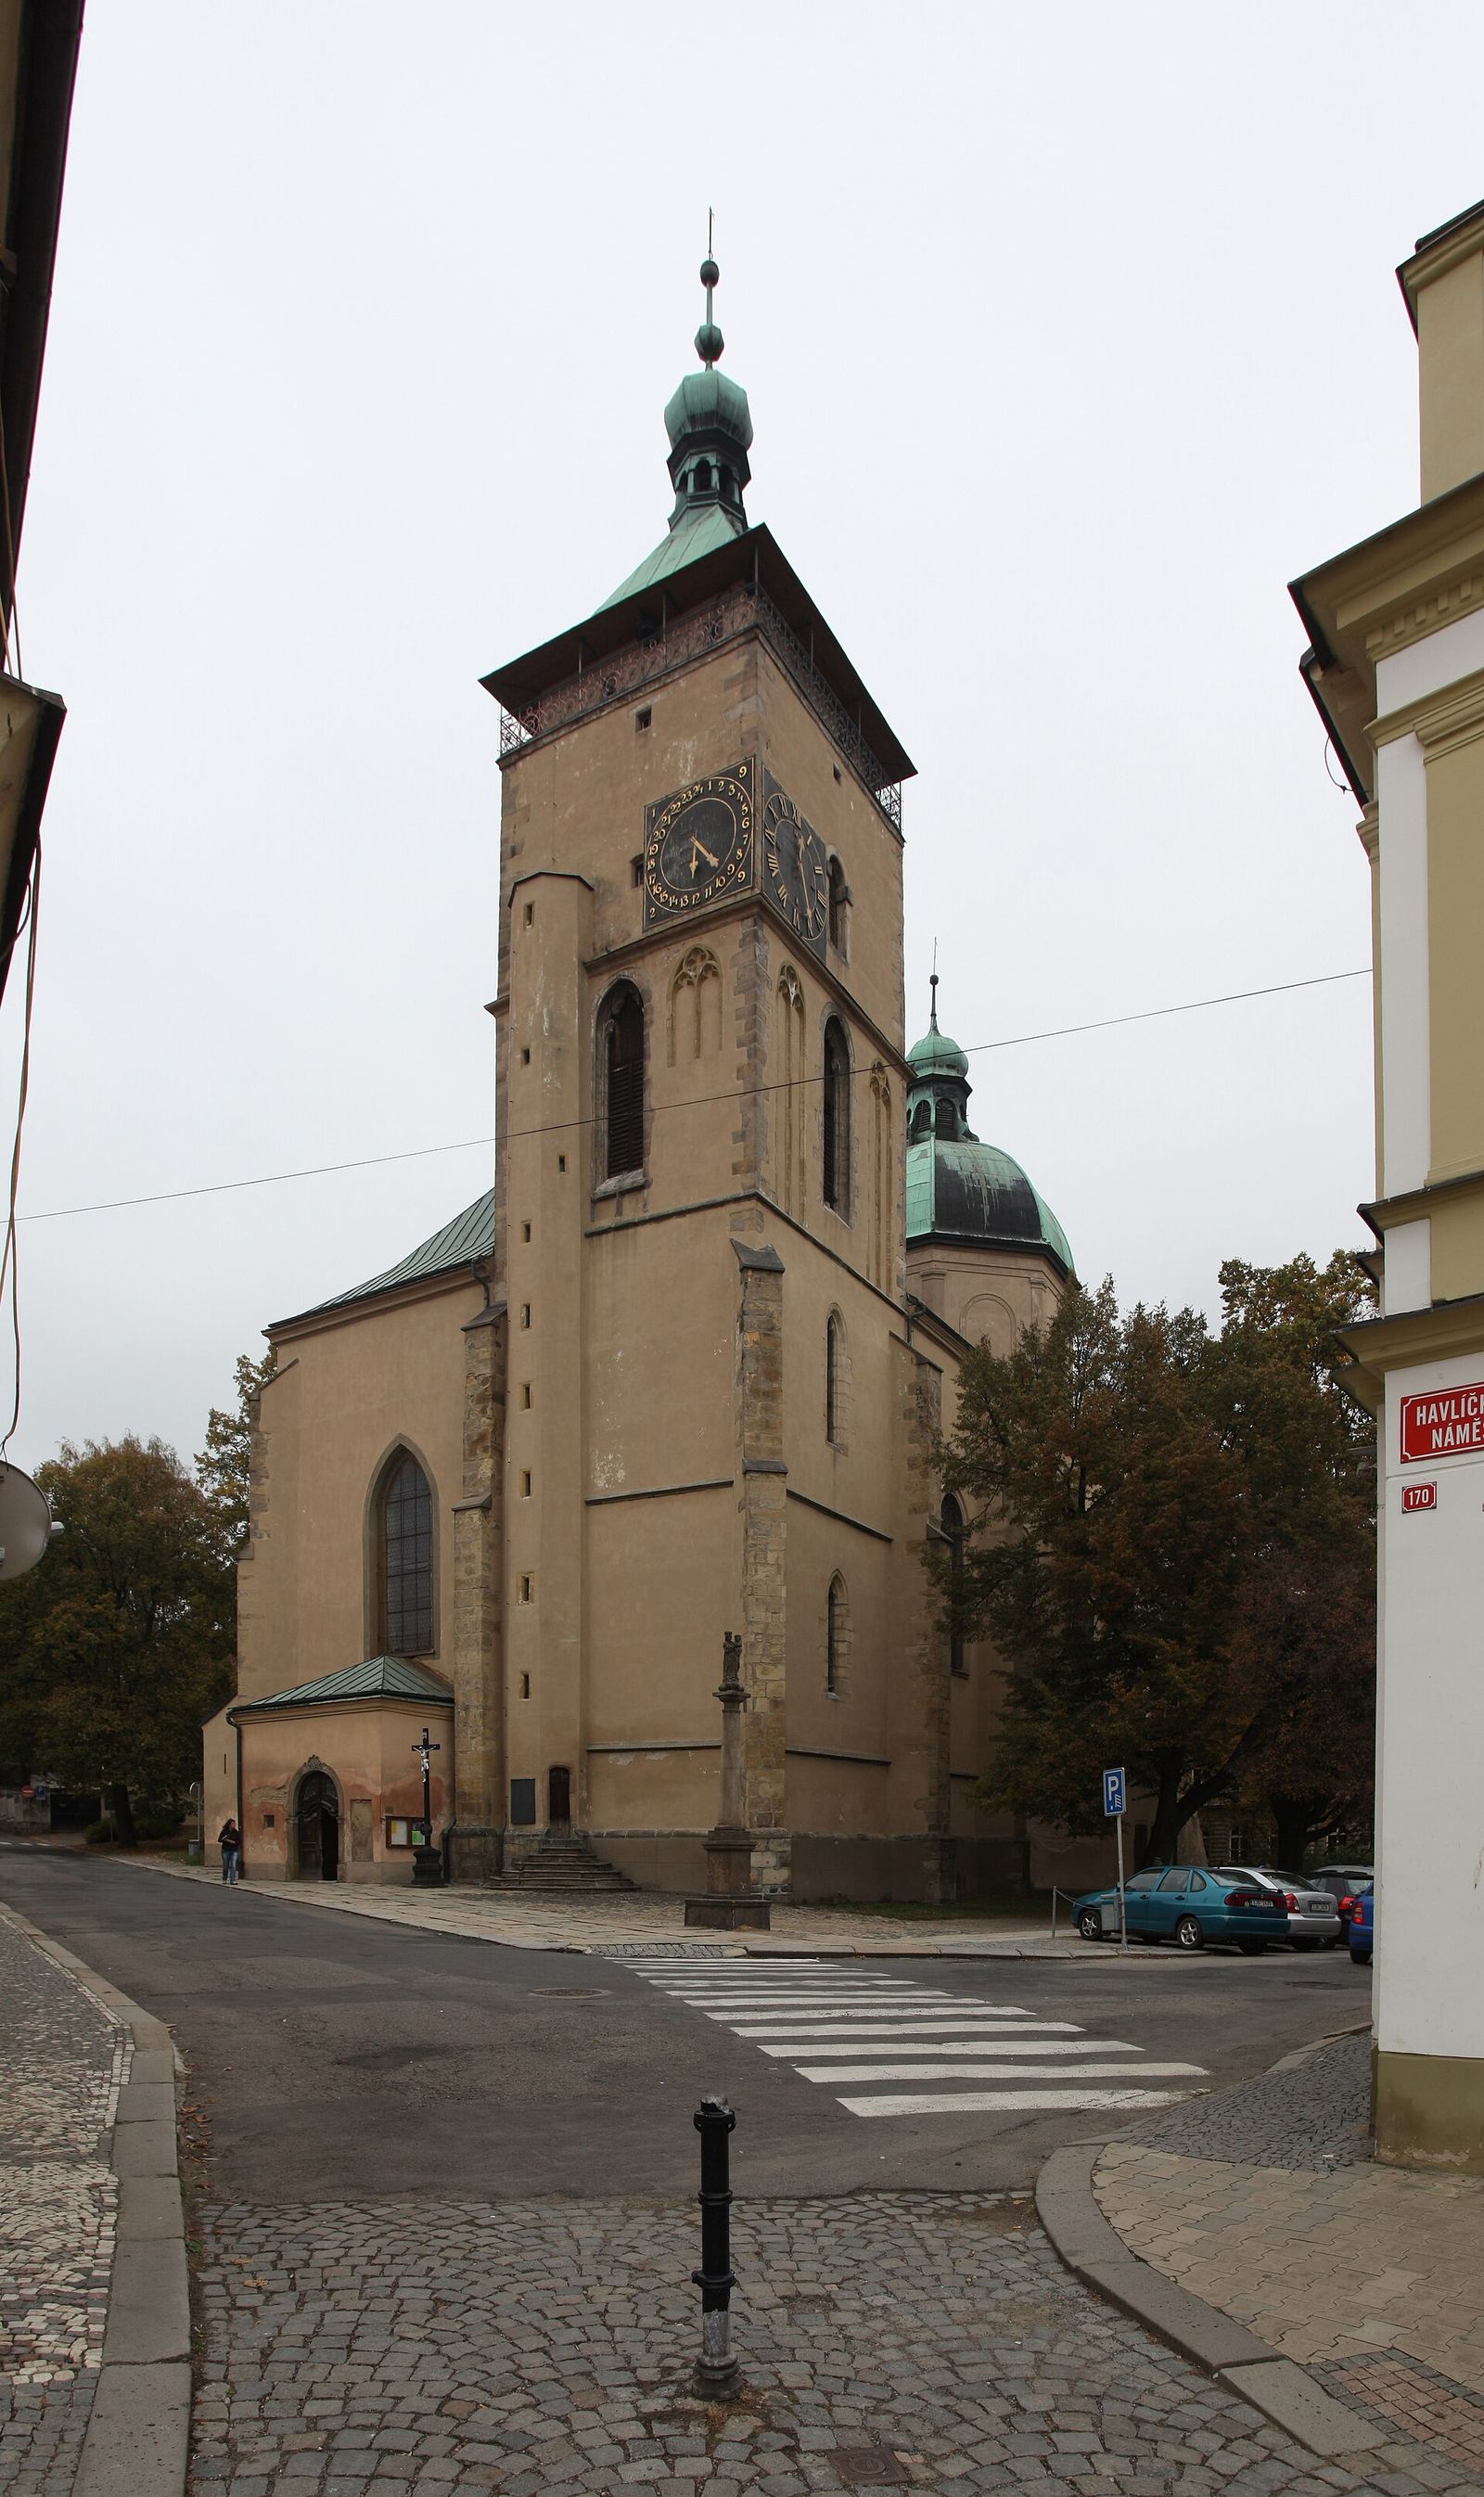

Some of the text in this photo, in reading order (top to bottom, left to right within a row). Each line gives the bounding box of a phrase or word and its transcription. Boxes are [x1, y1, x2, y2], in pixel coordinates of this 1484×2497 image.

[739, 766, 747, 777] 9
[693, 785, 703, 797] 24
[718, 780, 724, 791] 2
[729, 785, 736, 795] 3
[681, 790, 693, 803] 23
[670, 802, 681, 814] 22
[742, 804, 748, 815] 5
[661, 814, 671, 826] 21
[742, 817, 749, 828] 6
[653, 829, 666, 841] 20
[743, 835, 748, 845] 7
[648, 843, 659, 855] 19
[736, 849, 743, 860] 8
[647, 859, 655, 871] 18
[727, 864, 735, 875] 9
[649, 874, 657, 885] 17
[715, 877, 725, 888] 10
[737, 871, 746, 882] 9
[652, 883, 662, 895] 16
[705, 886, 712, 899] 11
[659, 890, 668, 903] 15
[669, 895, 678, 907] 14
[680, 895, 689, 907] 13
[692, 892, 700, 904] 12
[649, 907, 656, 918] 2
[1432, 1416, 1484, 1449] NÁMĚ
[1408, 1489, 1429, 1506] 170
[1108, 1776, 1119, 1801] P
